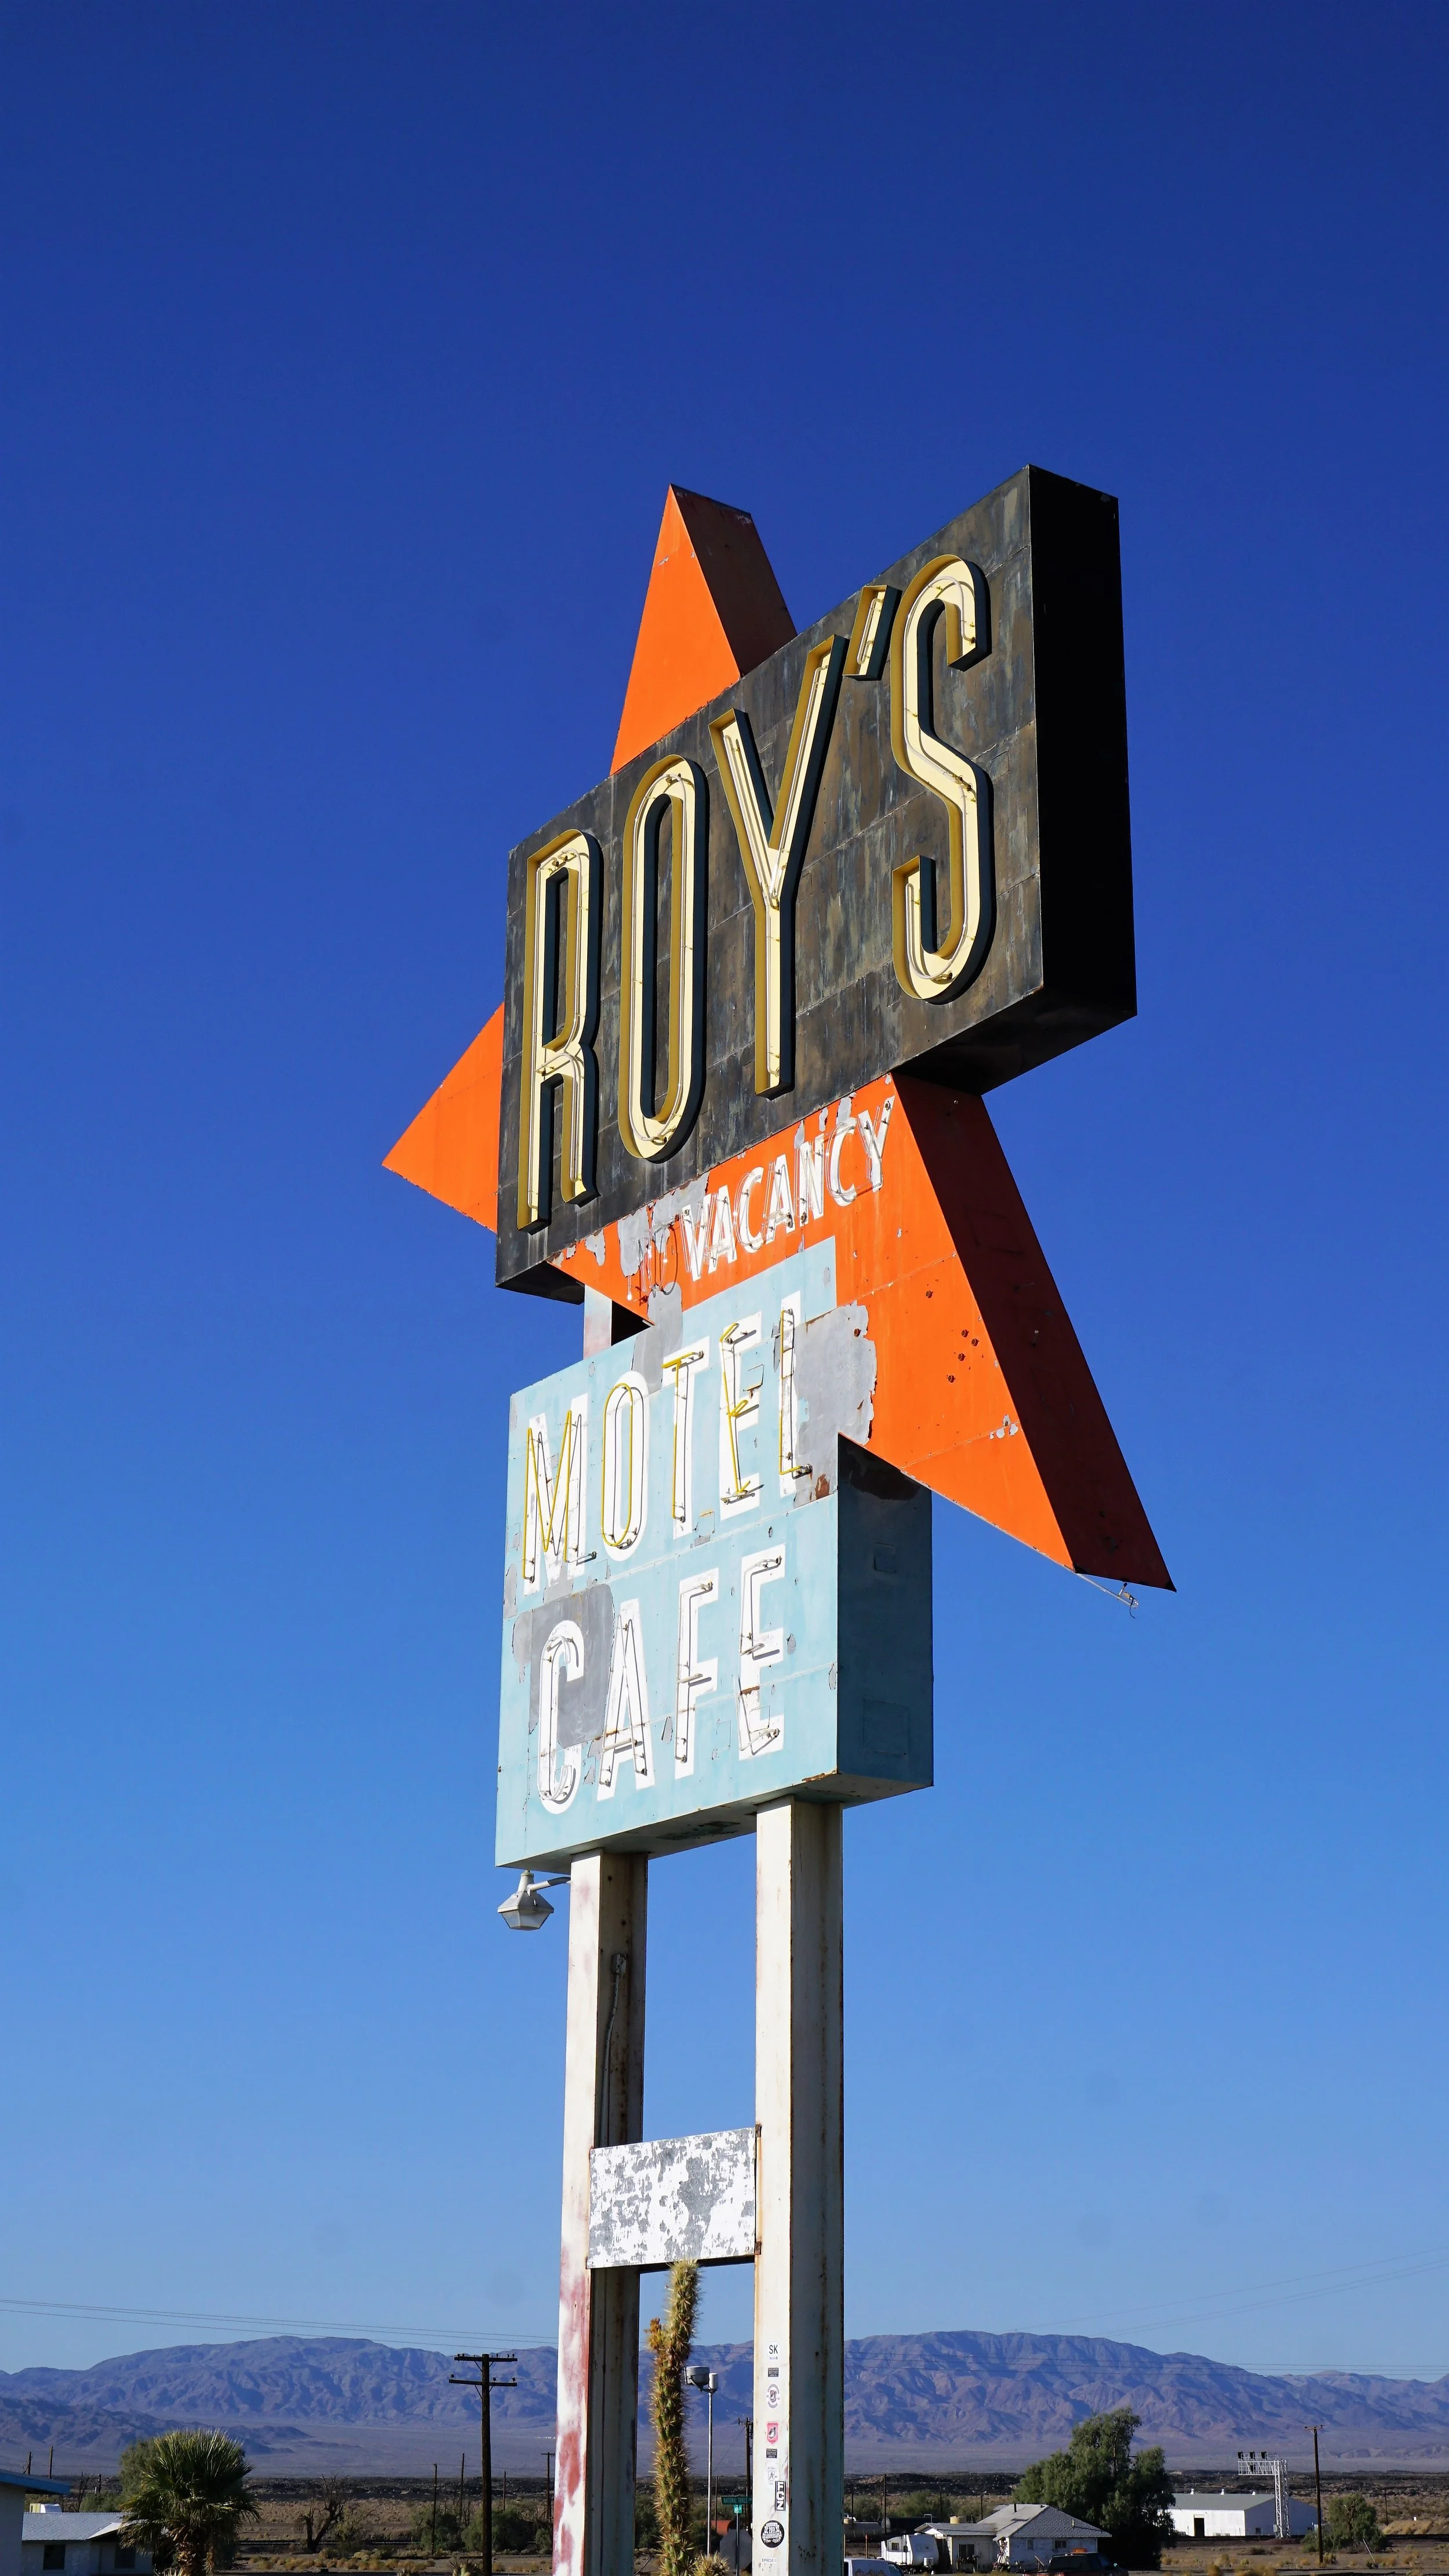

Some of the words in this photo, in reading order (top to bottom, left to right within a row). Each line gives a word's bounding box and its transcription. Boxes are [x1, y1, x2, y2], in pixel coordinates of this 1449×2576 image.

[518, 554, 991, 1233] ROY'S
[681, 1095, 895, 1282] VACANCY
[523, 1291, 813, 1596] MOTEL
[537, 1543, 786, 1814] CAFE
[769, 2345, 778, 2355] SK
